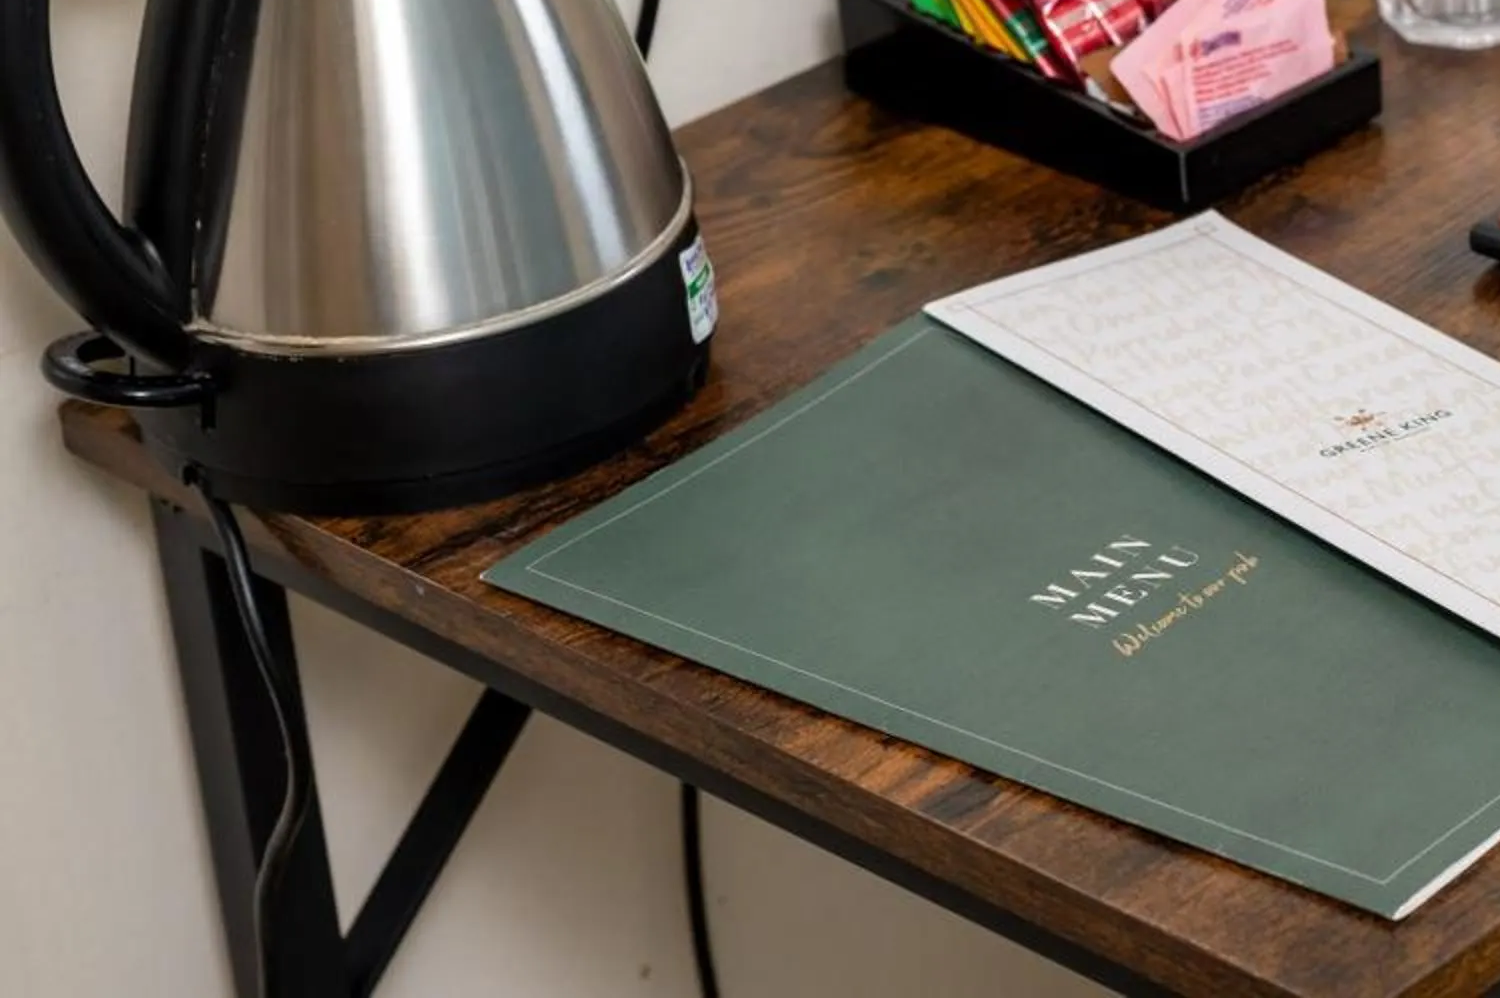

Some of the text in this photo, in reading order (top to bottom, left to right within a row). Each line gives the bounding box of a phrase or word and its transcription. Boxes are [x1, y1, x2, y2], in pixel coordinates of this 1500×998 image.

[1319, 427, 1400, 457] GREENE
[1399, 408, 1455, 432] KING
[1029, 534, 1152, 610] MAIN
[1069, 545, 1200, 630] MENU
[1112, 605, 1187, 657] Welcome
[1227, 550, 1259, 585] pub
